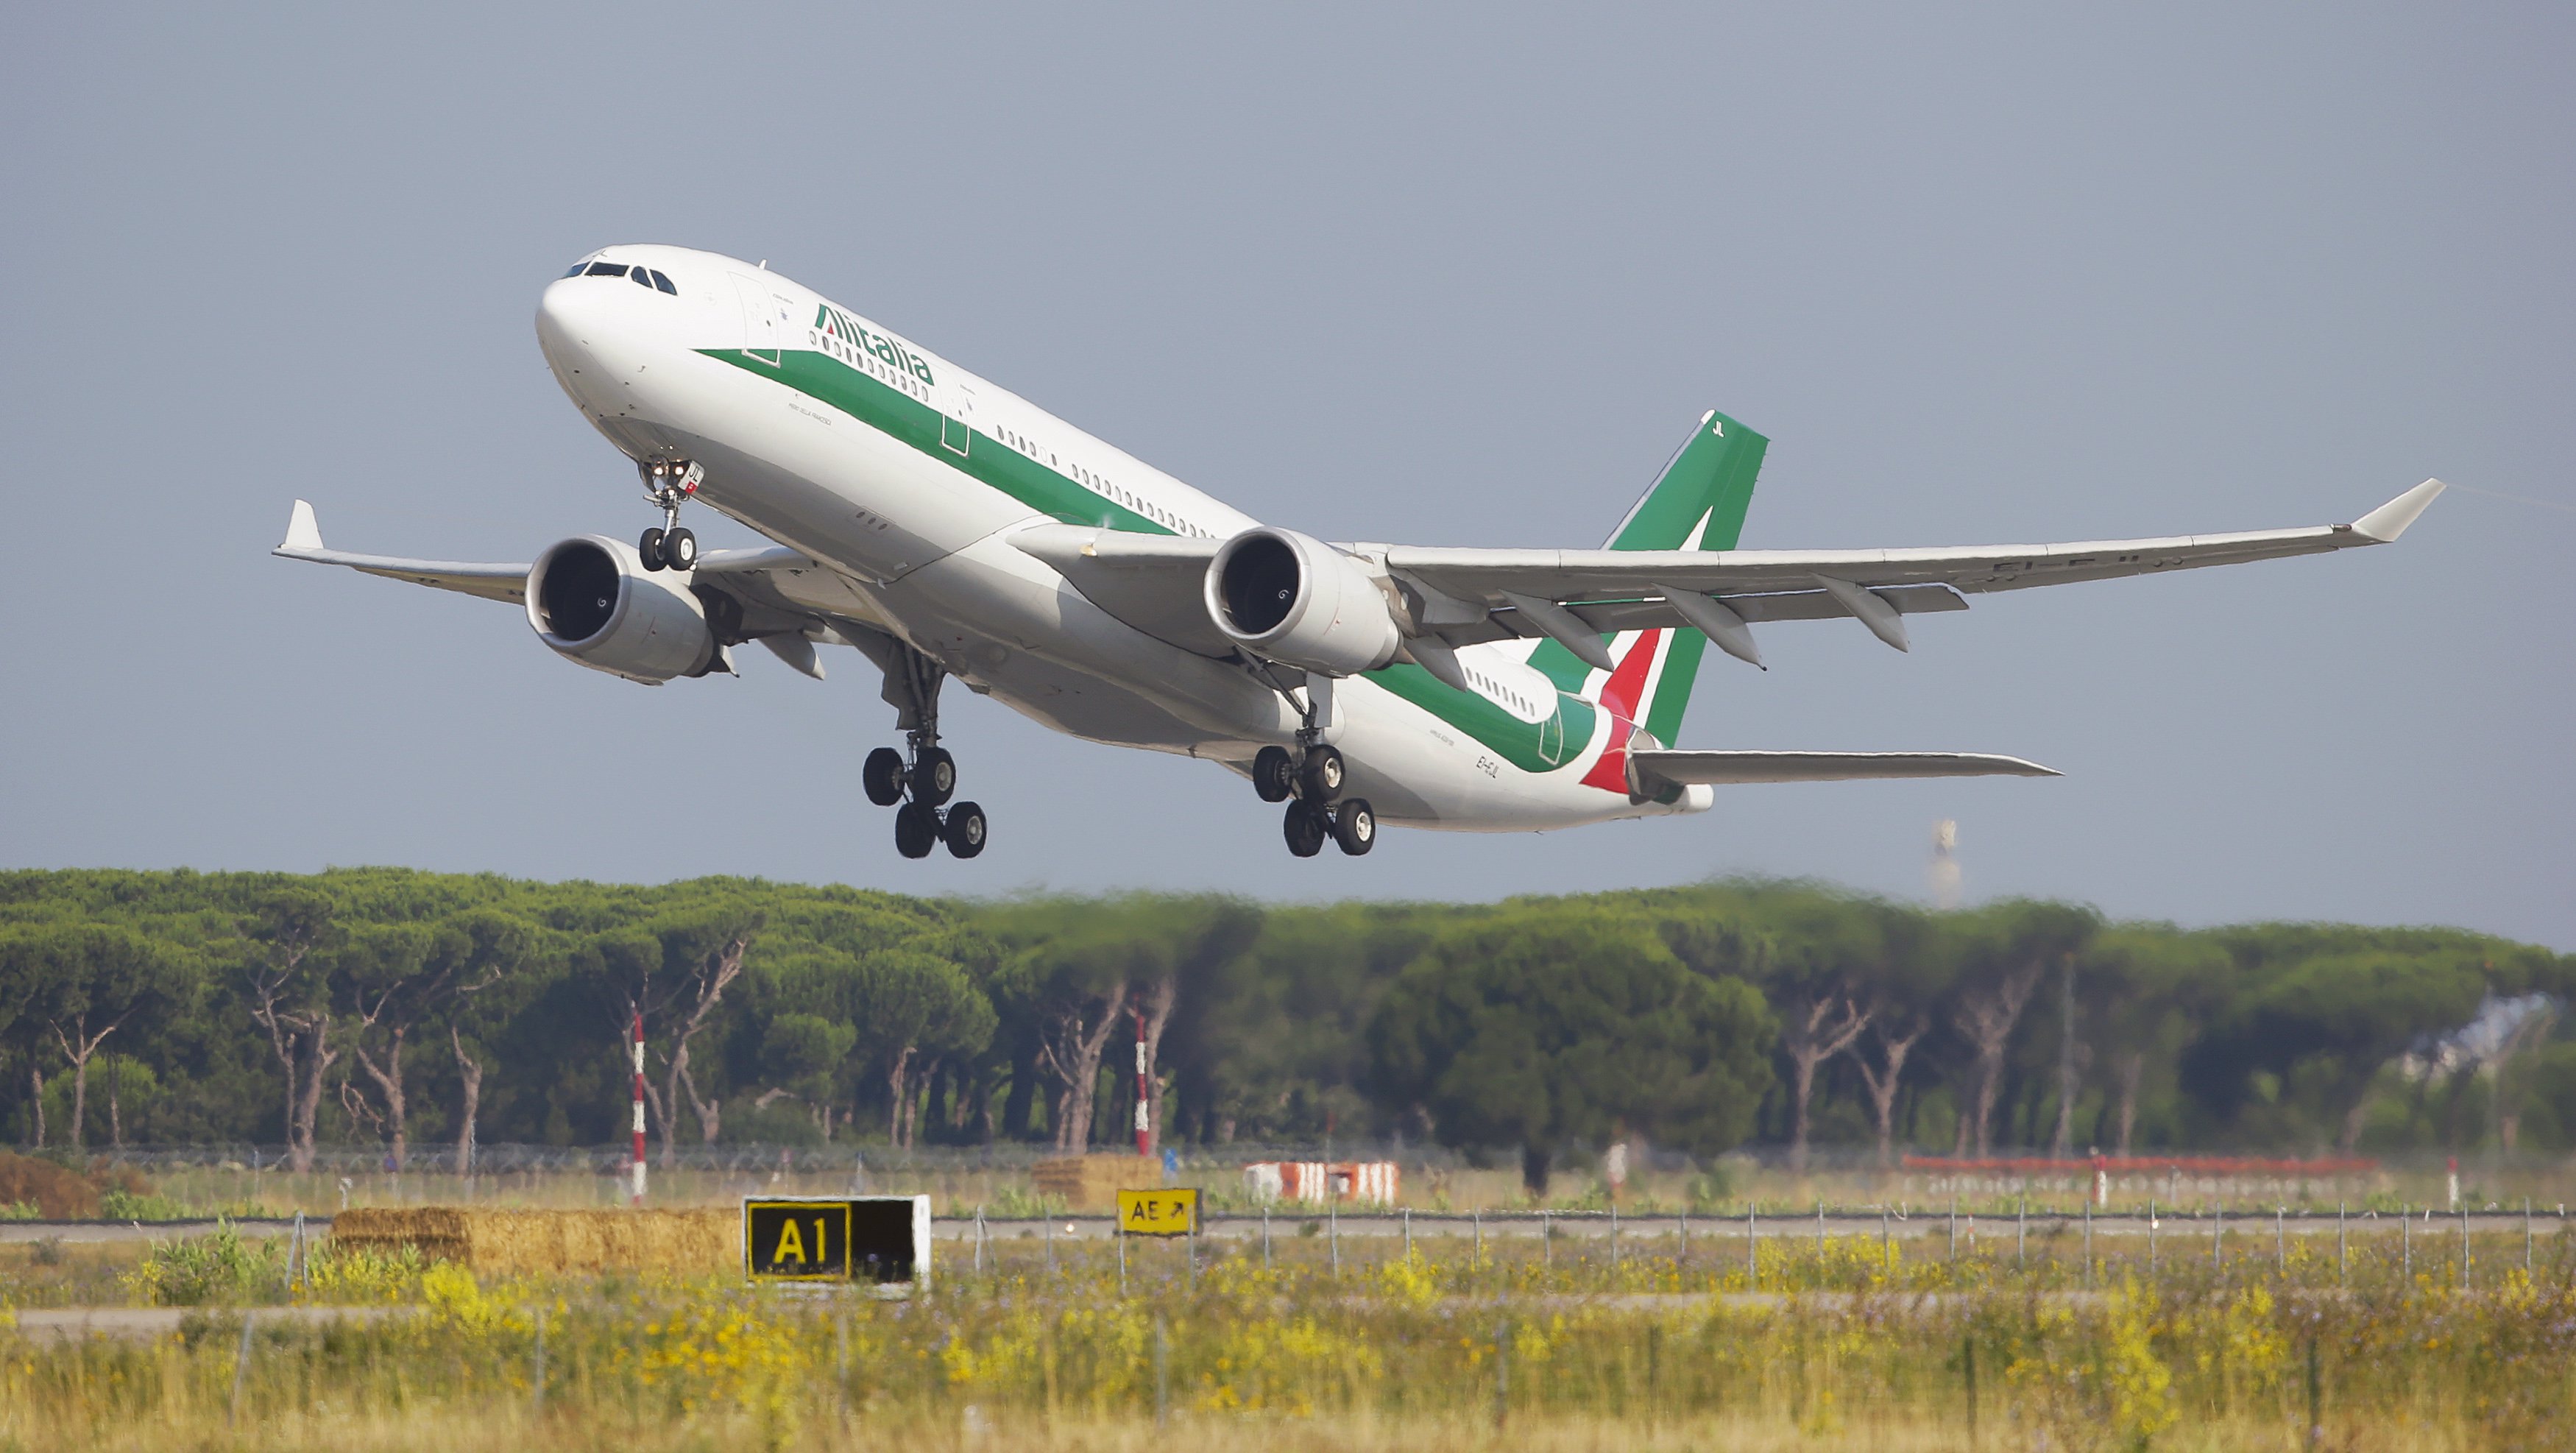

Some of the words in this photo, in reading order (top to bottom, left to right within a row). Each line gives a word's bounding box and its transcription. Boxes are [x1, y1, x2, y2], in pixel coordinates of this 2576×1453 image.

[815, 303, 935, 386] Alitalia
[1712, 420, 1724, 438] JL
[689, 466, 700, 482] JL
[1131, 1201, 1159, 1221] AE
[773, 1217, 827, 1264] A1
